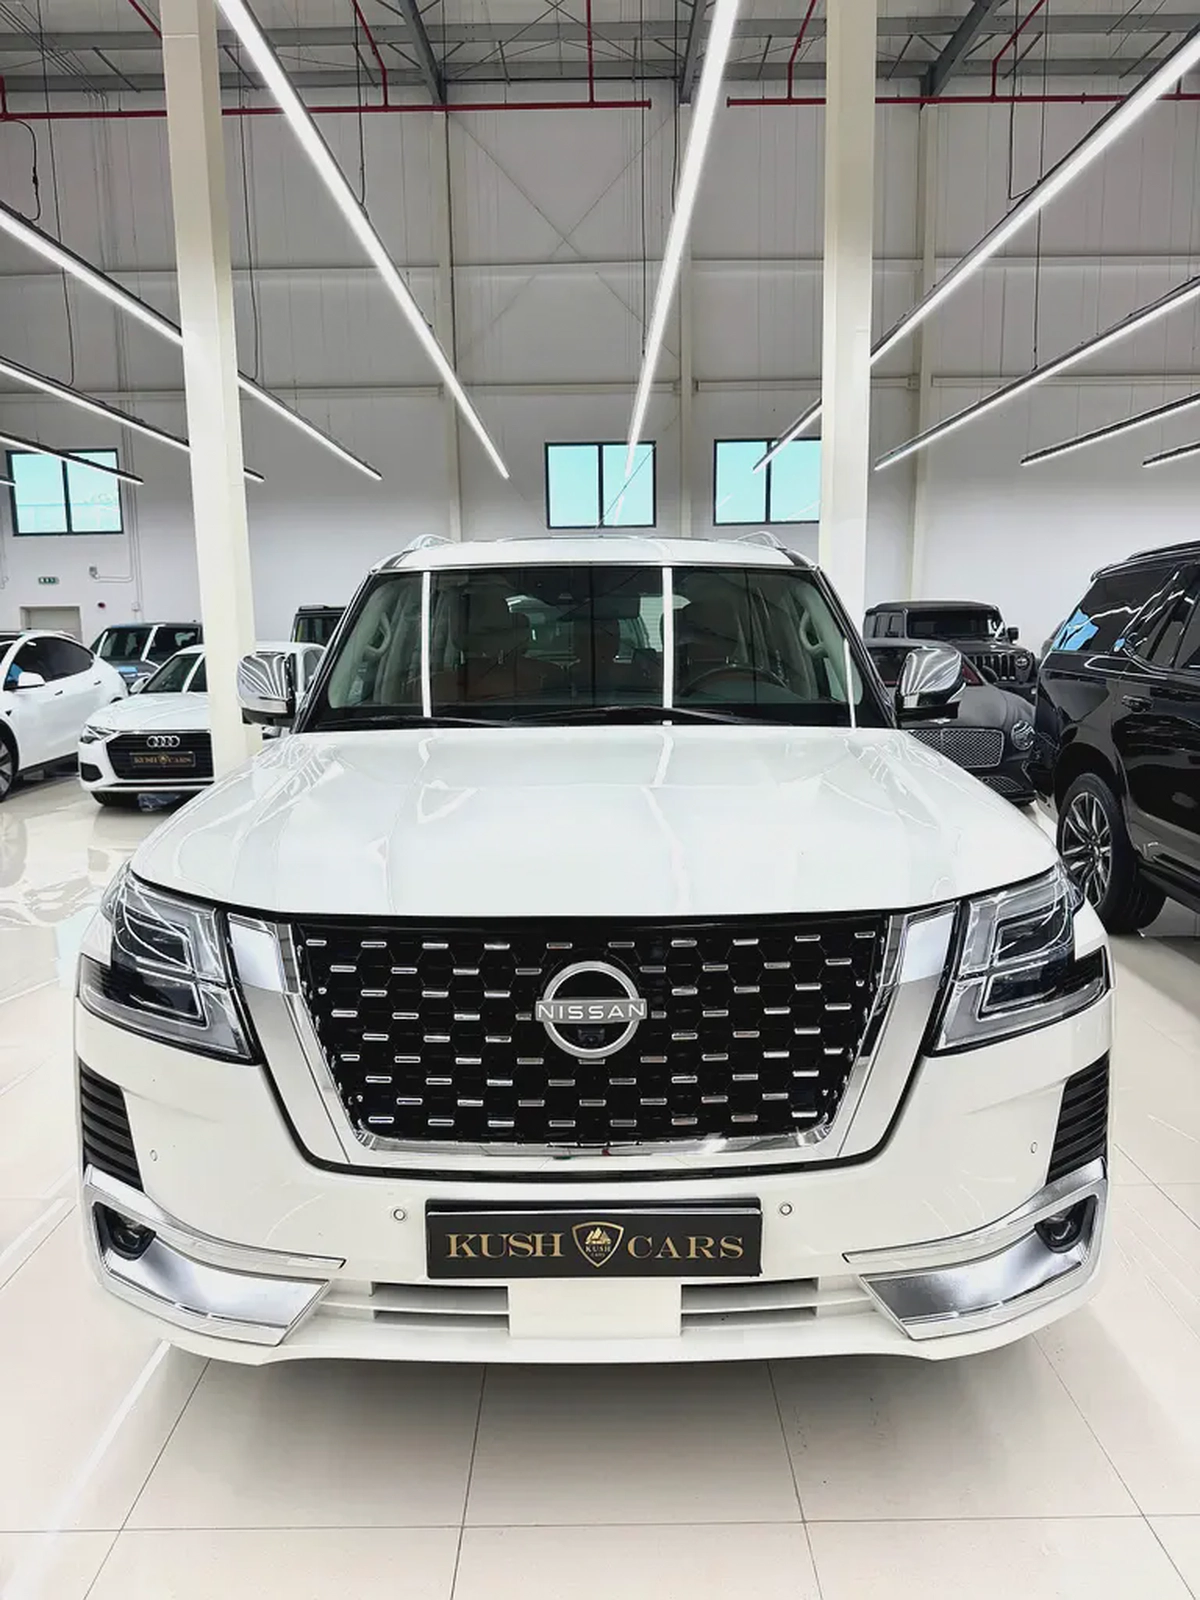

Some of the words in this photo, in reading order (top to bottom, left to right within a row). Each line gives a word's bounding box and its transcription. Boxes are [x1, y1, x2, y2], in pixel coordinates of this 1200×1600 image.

[538, 1003, 645, 1020] NISSAN
[445, 1232, 566, 1259] KUSH
[626, 1234, 744, 1259] CARS
